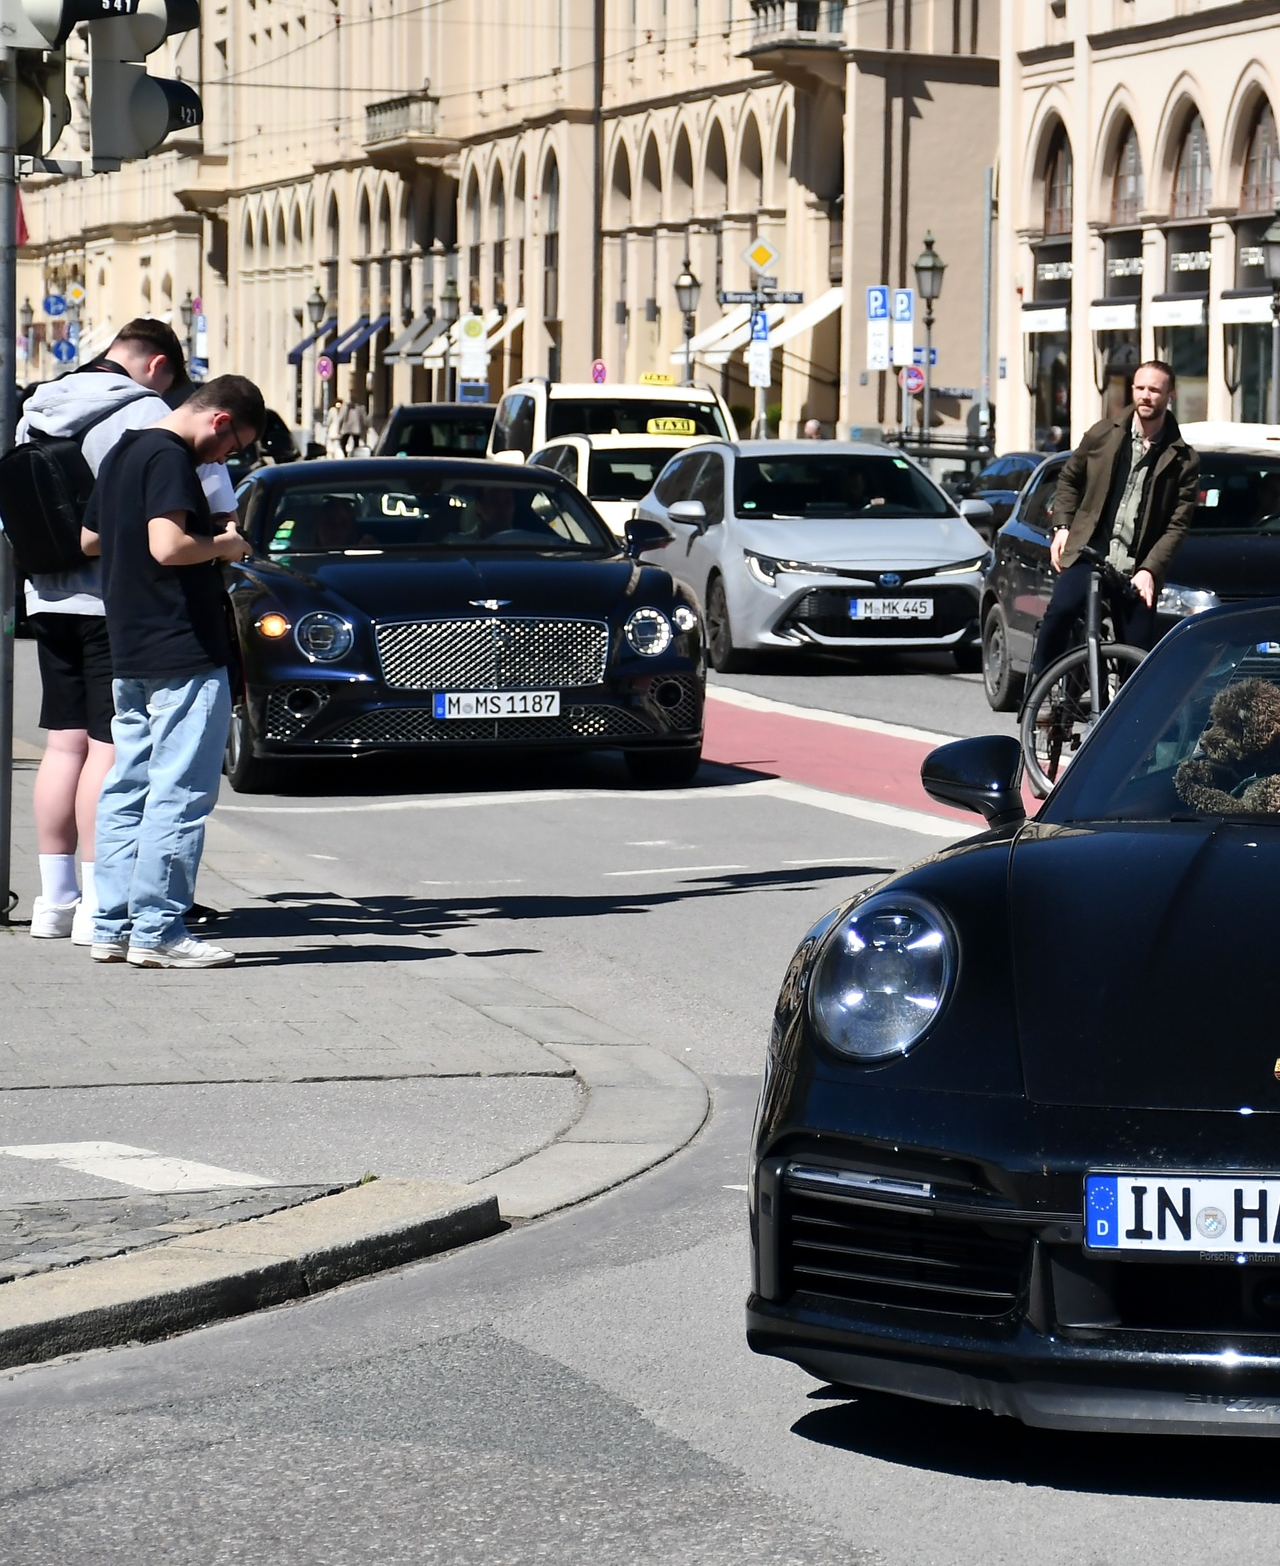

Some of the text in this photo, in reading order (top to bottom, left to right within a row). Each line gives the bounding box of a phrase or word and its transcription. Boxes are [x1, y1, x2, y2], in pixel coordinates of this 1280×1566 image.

[654, 419, 690, 431] TAXI
[864, 601, 927, 614] M MK 445
[448, 694, 556, 715] M MS 1187
[1125, 1185, 1192, 1241] IN
[1097, 1219, 1110, 1236] D
[1200, 1251, 1235, 1262] Porsche
[1236, 1252, 1276, 1263] entrum
